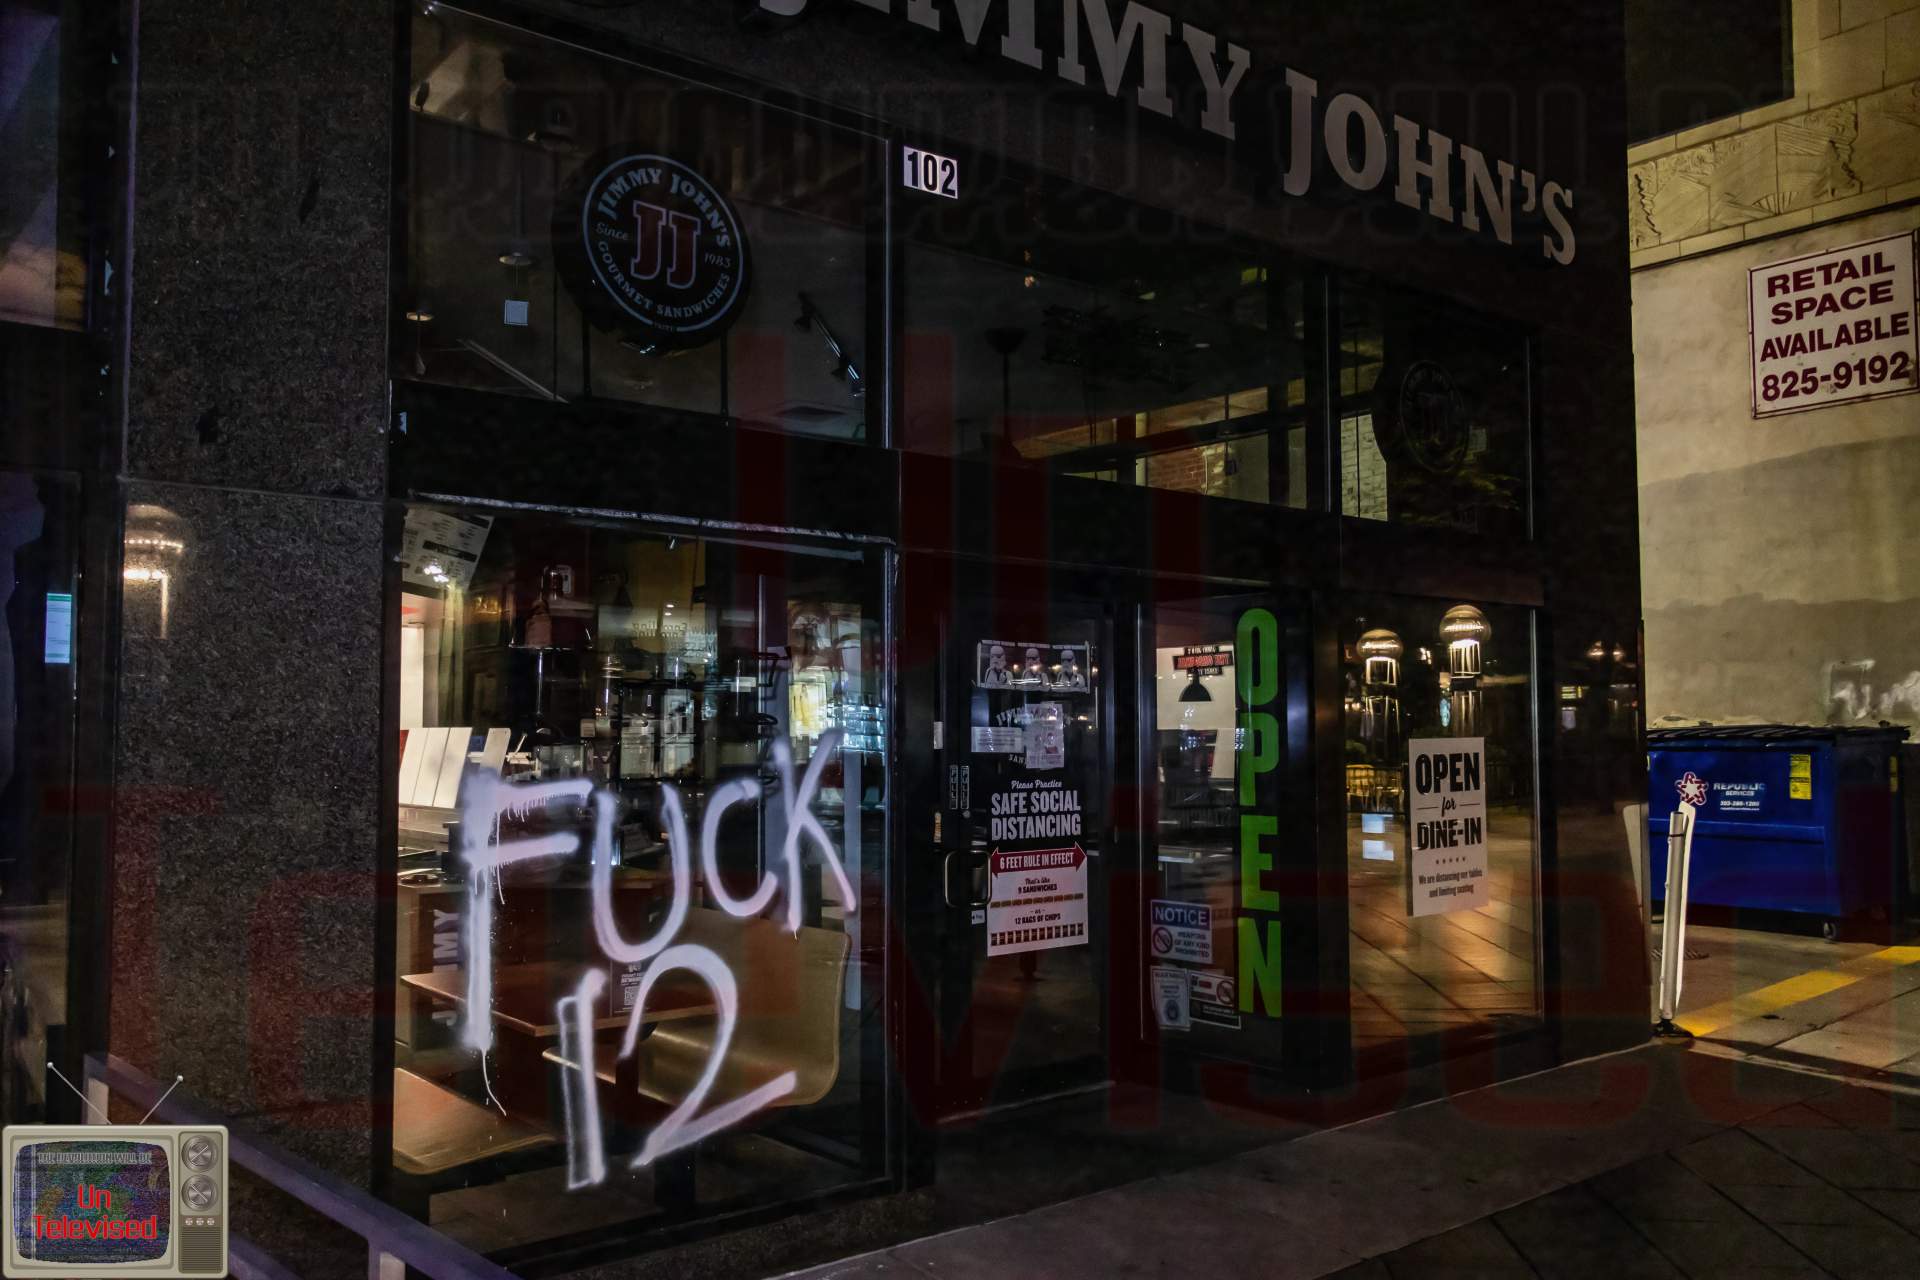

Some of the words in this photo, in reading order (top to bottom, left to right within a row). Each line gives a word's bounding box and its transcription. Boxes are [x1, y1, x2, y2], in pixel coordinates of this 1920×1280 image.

[759, 0, 1251, 140] MMY
[1283, 67, 1576, 266] JOHN'S
[907, 151, 956, 197] 102
[597, 167, 662, 221] JIMMY
[670, 173, 731, 248] JOHN'S
[595, 222, 629, 241] Since
[630, 200, 701, 289] JJ
[597, 241, 654, 310] GOURMET
[656, 272, 731, 319] SANDWICHES
[704, 252, 731, 269] 1983
[1767, 252, 1895, 298] RETAIL
[1771, 280, 1894, 325] SPACE
[1760, 312, 1910, 362] AVAILABLE
[1762, 351, 1910, 401] 825-9192
[1011, 780, 1034, 790] Please
[1035, 779, 1063, 789] Practice
[1415, 752, 1481, 795] OPEN
[992, 792, 1027, 815] SAFE
[1030, 790, 1081, 814] SOCIAL
[1236, 608, 1282, 1018] OPEN
[1441, 797, 1456, 817] for
[992, 813, 1081, 840] DISTANCING
[1416, 817, 1482, 851] DINE-IN
[1000, 857, 1005, 870] 6
[1006, 856, 1022, 869] FEET
[1023, 855, 1041, 867] RULE
[1041, 854, 1049, 866] IN
[1050, 852, 1074, 865] EFFECT
[1419, 875, 1426, 884] We
[1427, 876, 1435, 884] are
[1436, 872, 1460, 882] distancing
[463, 728, 857, 1058] FUCK
[1023, 884, 1058, 893] SANDWICHES
[1429, 888, 1438, 898] and
[1022, 916, 1035, 924] BAGS
[1045, 913, 1061, 922] CHIPS
[1154, 906, 1208, 926] NOTICE
[432, 908, 459, 1027] JMY
[557, 943, 797, 1191] 12
